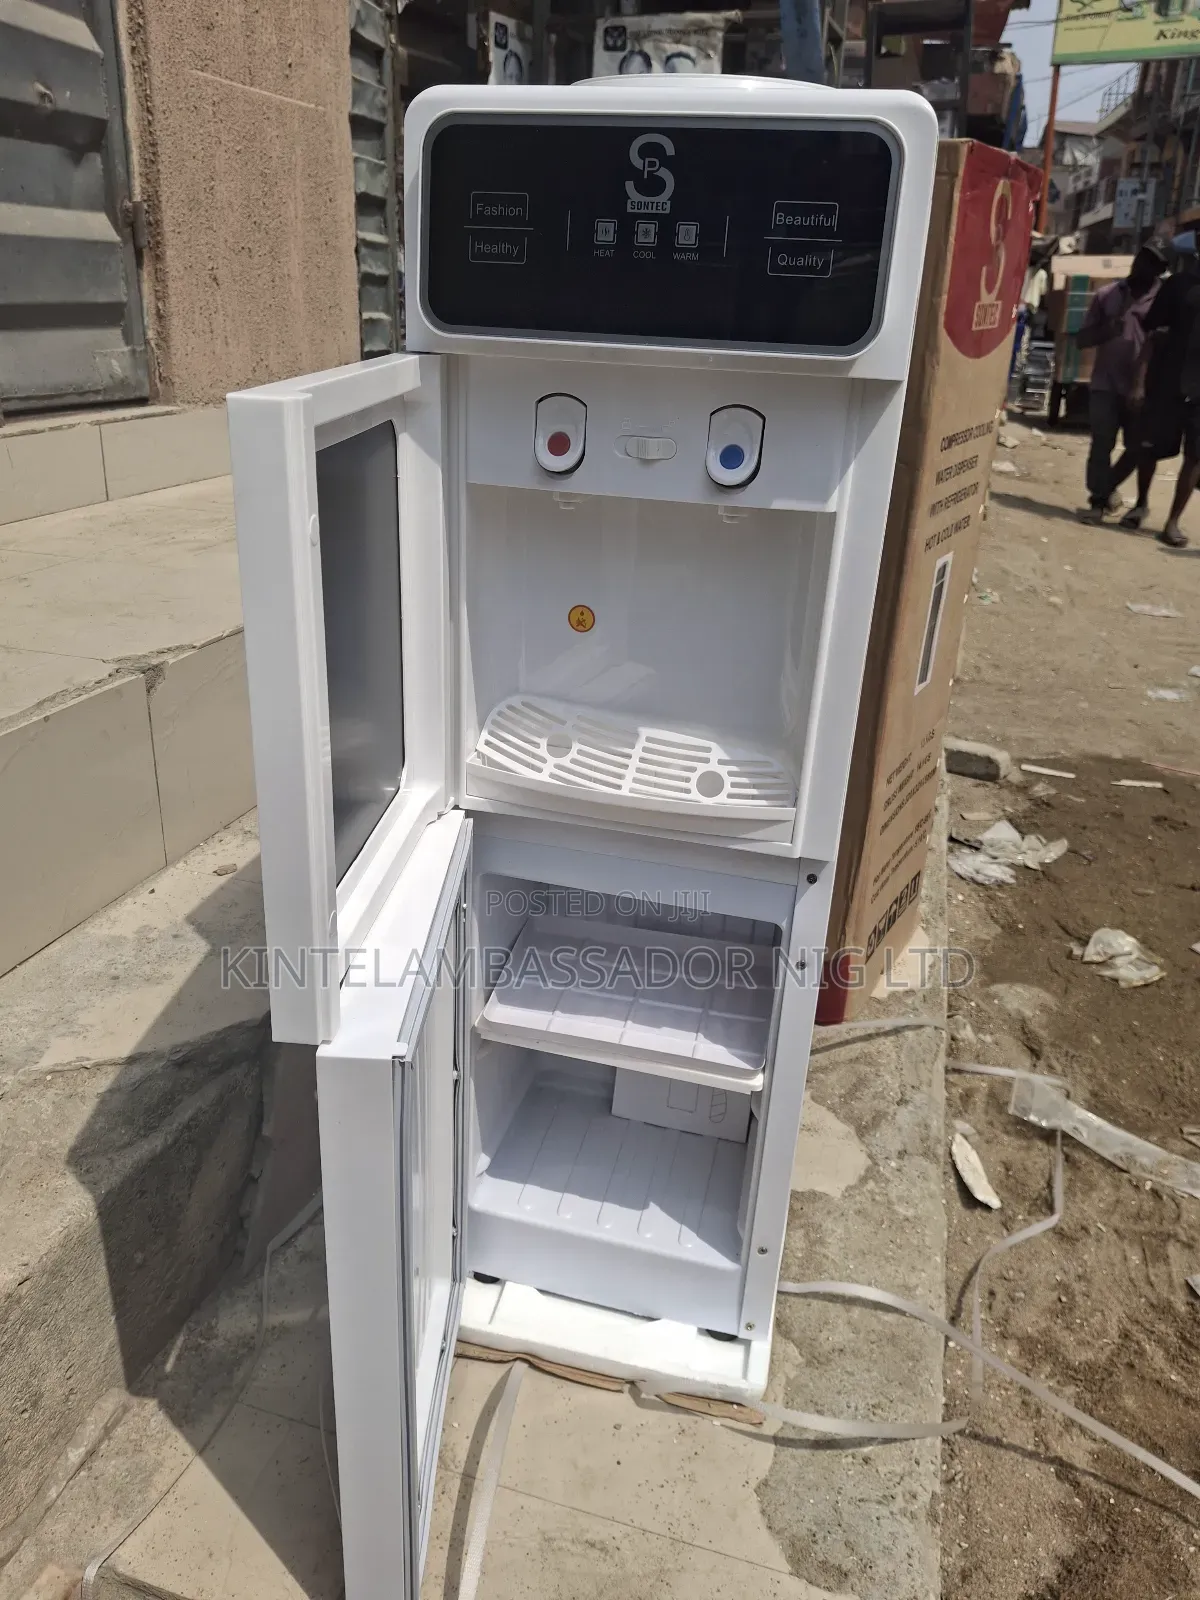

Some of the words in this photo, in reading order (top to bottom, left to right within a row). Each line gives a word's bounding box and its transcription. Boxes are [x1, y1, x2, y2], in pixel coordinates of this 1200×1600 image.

[476, 203, 523, 217] Fashion
[630, 200, 668, 212] SONTEC
[776, 212, 836, 227] Beautiful
[474, 241, 519, 258] Healthy
[593, 248, 615, 258] HEAT
[632, 250, 656, 260] COOL
[672, 252, 699, 261] WARM
[777, 253, 824, 270] Quality
[940, 427, 974, 453] COMPRESSOR
[924, 533, 938, 553] HOT
